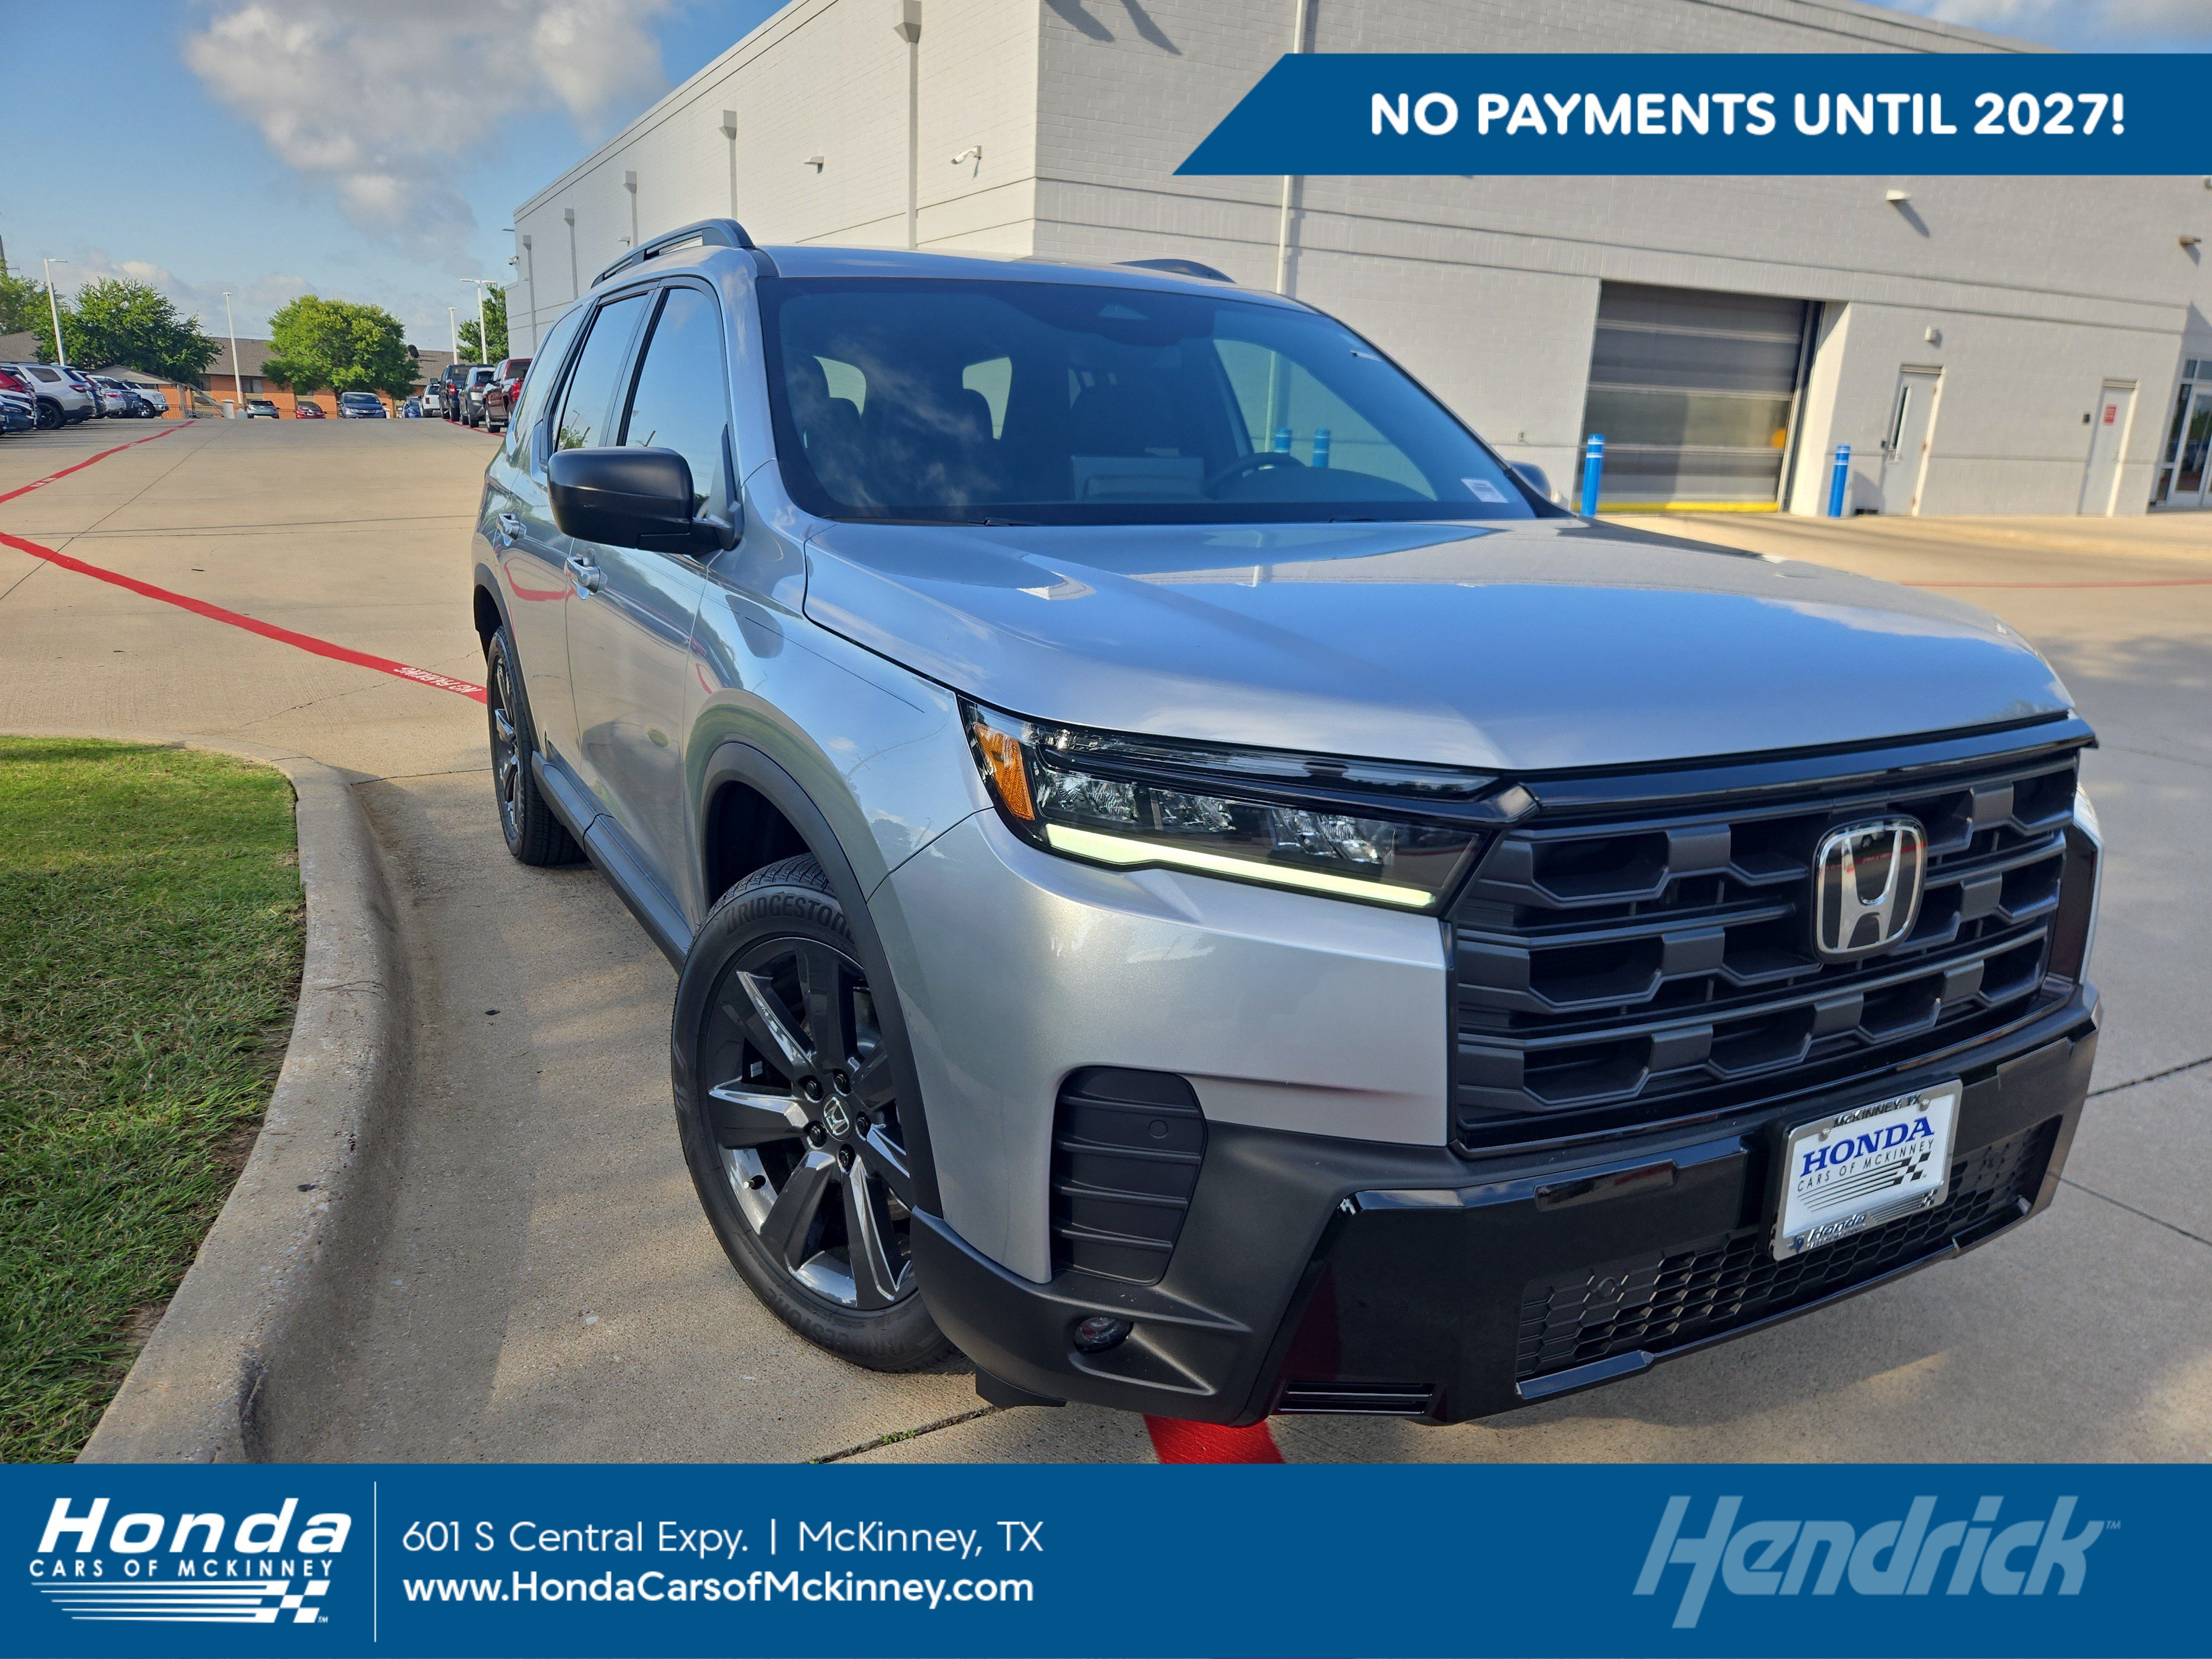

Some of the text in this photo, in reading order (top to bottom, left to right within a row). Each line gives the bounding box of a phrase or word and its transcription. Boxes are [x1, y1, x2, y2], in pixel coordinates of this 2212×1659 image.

[724, 893, 856, 944] BRIDGESTON
[1797, 1137, 1934, 1192] CARS OF MCKINNEY
[1799, 1115, 1935, 1178] HONDA
